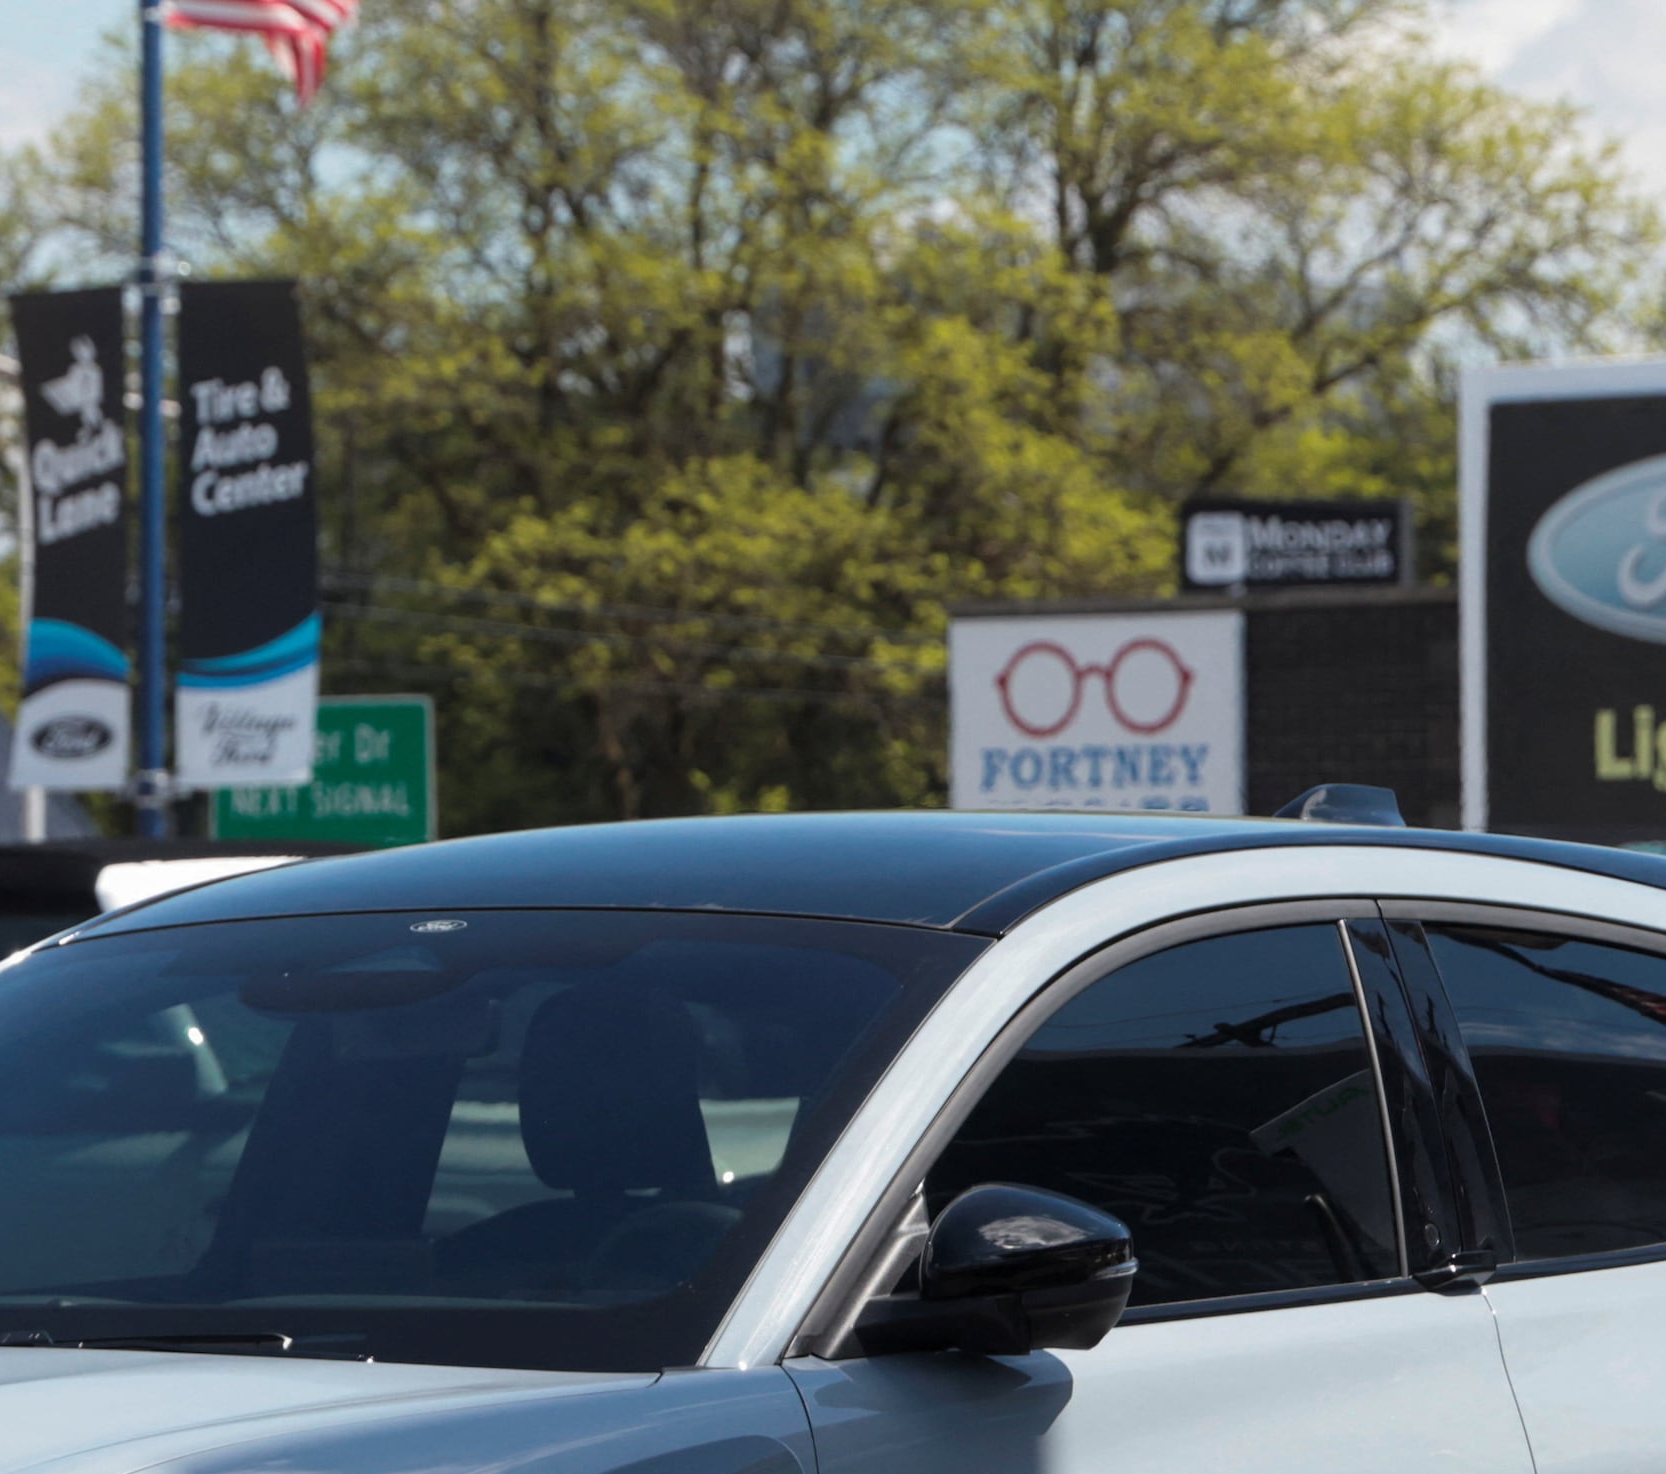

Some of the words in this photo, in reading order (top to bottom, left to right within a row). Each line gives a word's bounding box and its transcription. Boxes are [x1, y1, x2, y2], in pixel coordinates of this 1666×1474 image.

[190, 376, 259, 425] Tire
[260, 365, 290, 413] &
[190, 421, 279, 472] Auto
[37, 481, 120, 545] Lane
[190, 462, 310, 517] Center
[980, 742, 1211, 794] FORTNEY
